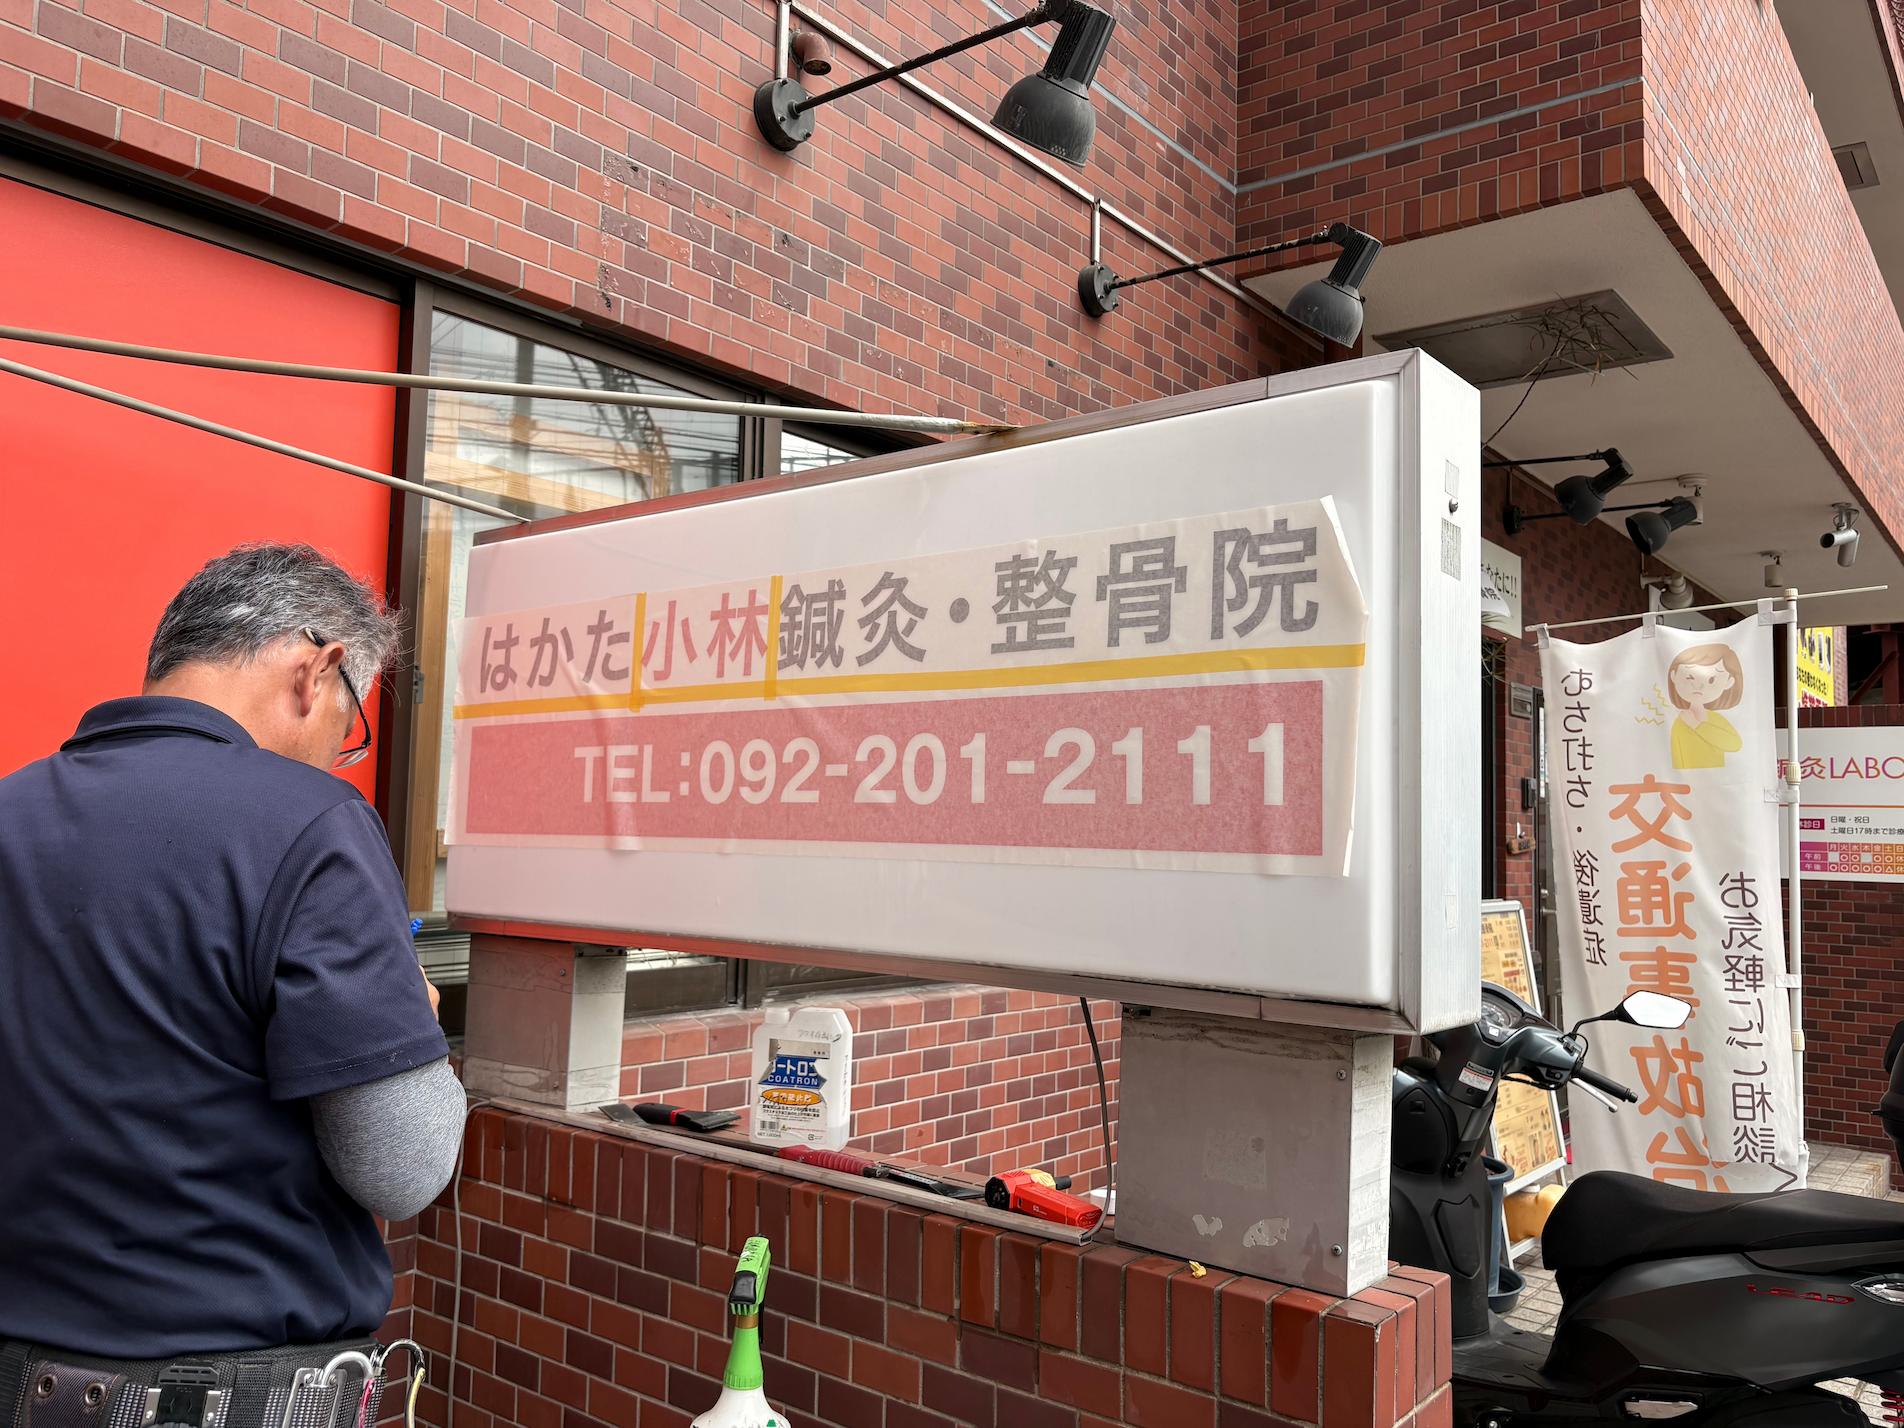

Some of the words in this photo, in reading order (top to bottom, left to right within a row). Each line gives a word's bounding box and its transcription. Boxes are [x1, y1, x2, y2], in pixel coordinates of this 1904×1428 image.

[574, 722, 1285, 806] TEL:092-201-2111
[1830, 815, 1870, 824] 日曜・祝日
[767, 1074, 818, 1086] COATRON
